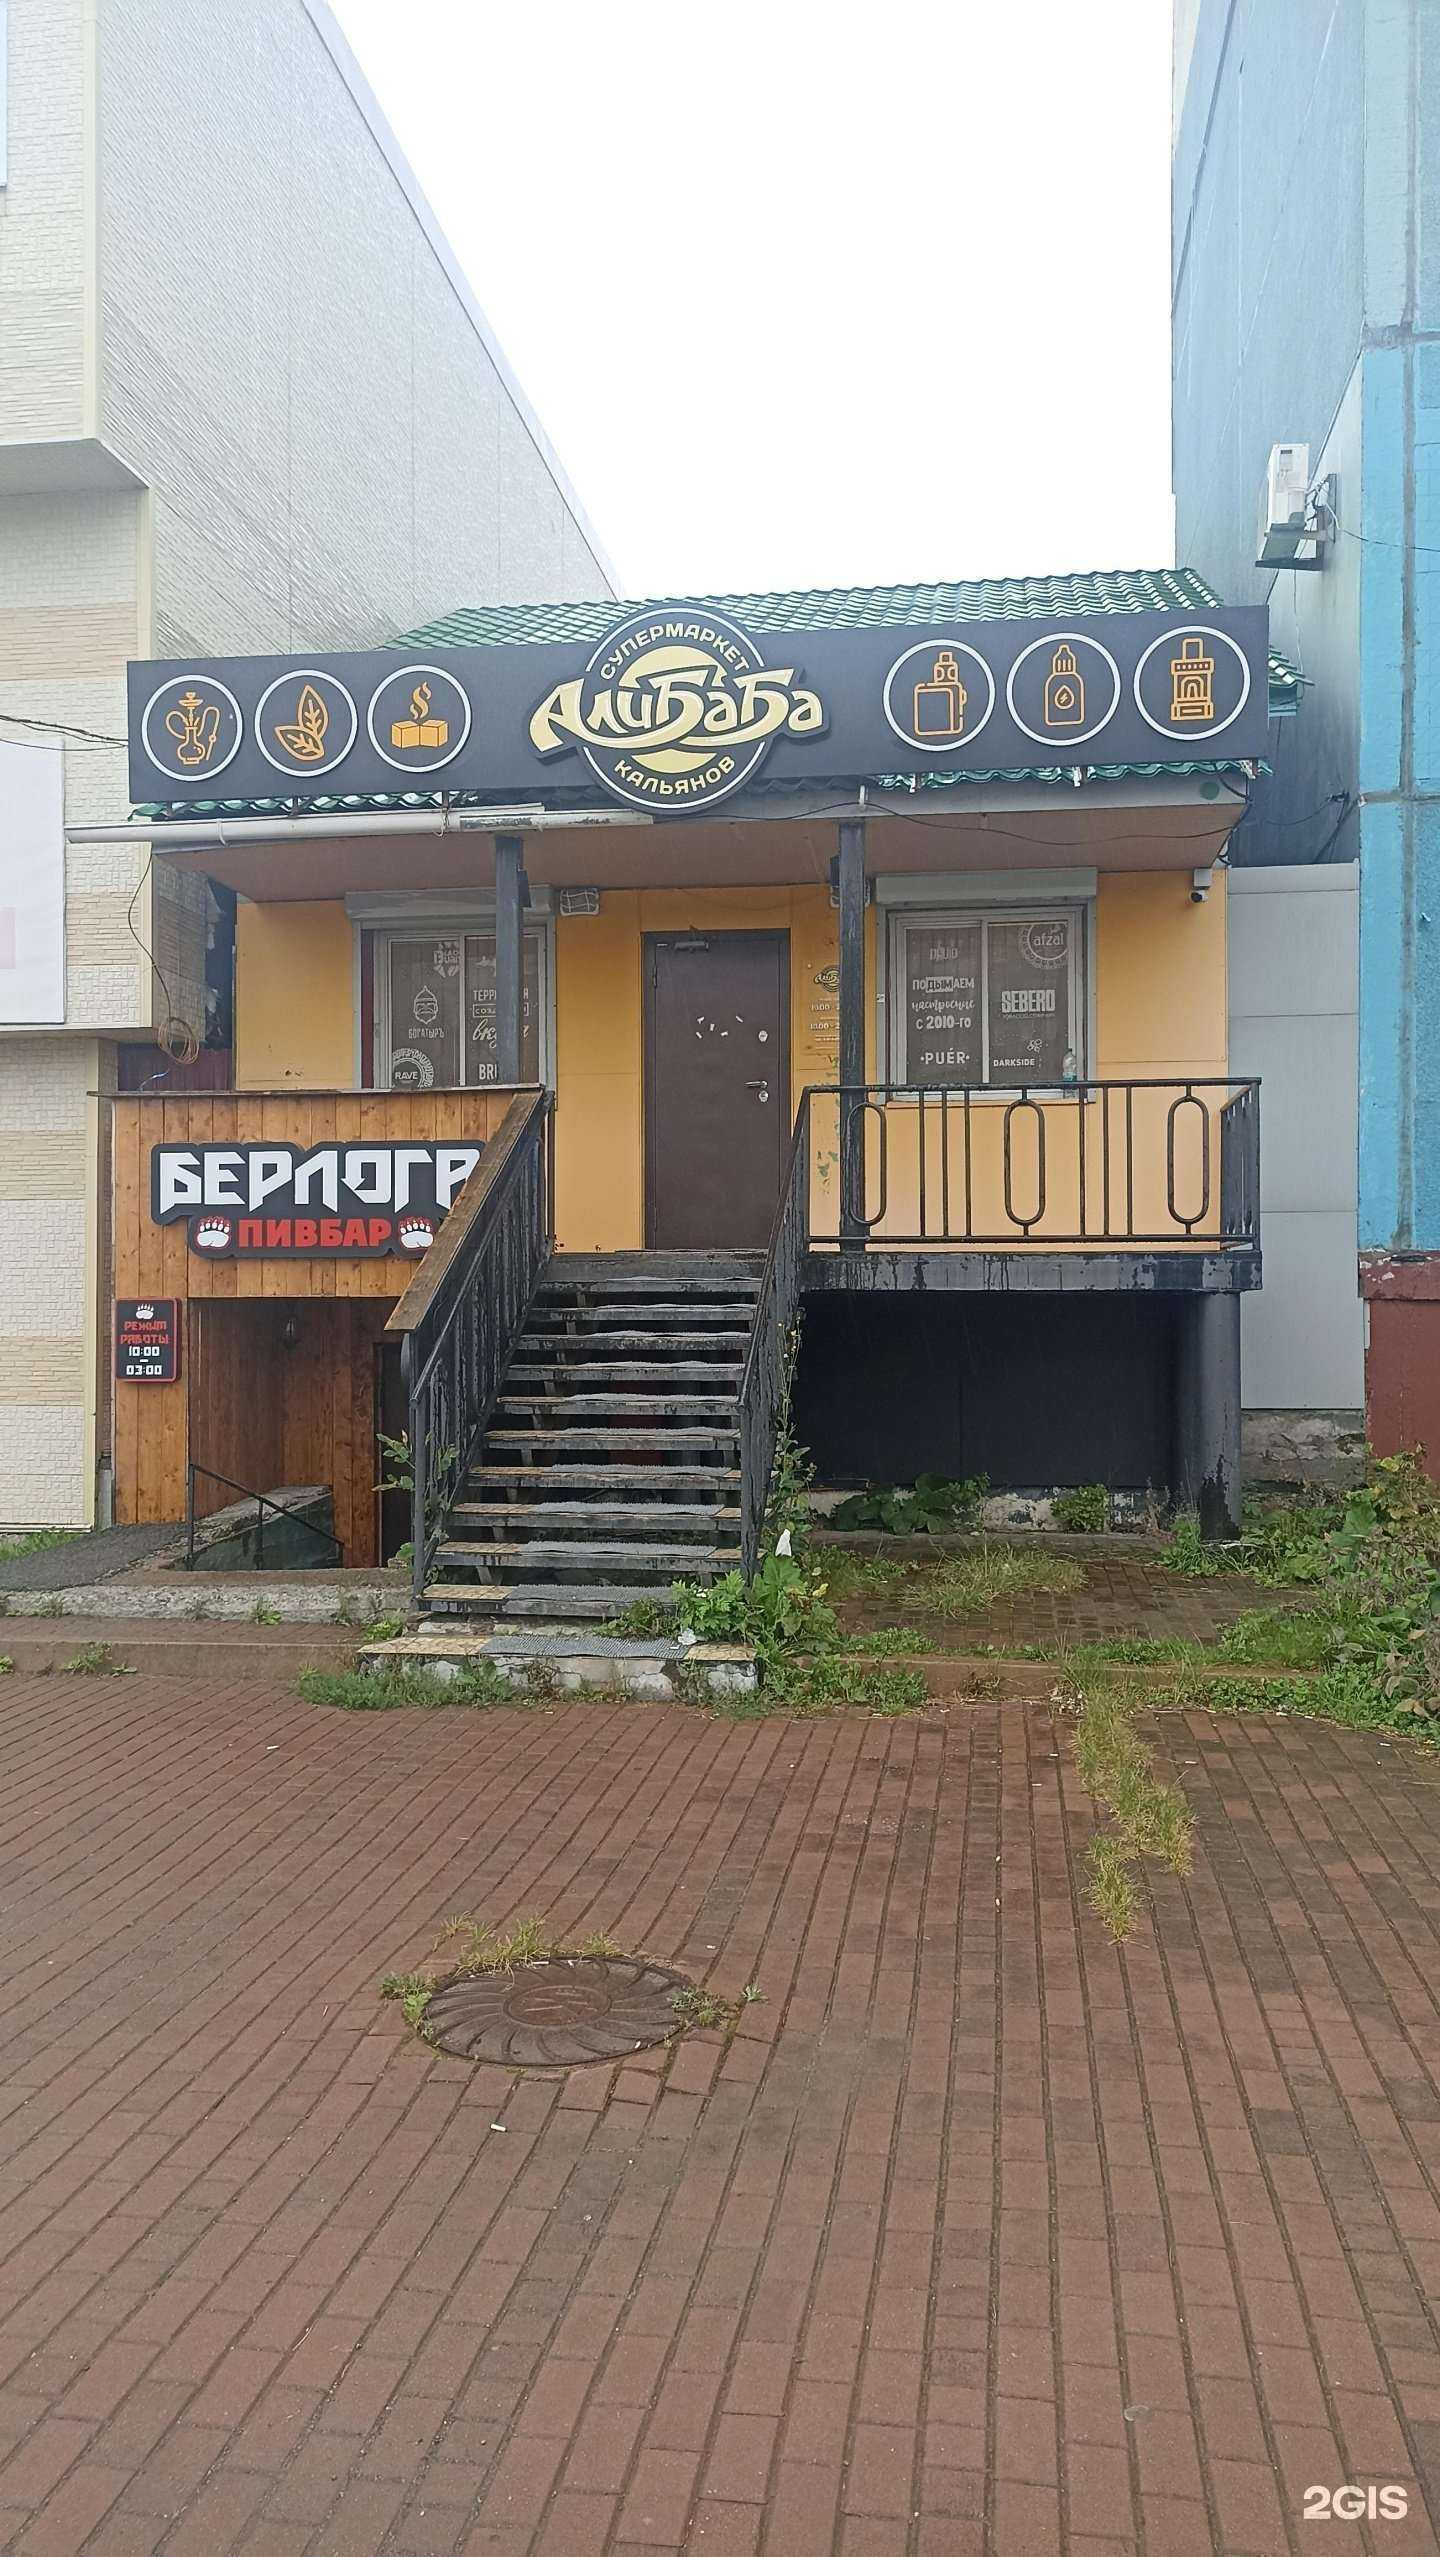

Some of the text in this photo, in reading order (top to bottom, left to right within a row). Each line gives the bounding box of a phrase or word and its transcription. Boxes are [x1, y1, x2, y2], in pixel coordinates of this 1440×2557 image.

[600, 622, 750, 681] СУПЕРМАРКЕТ
[614, 755, 736, 795] КАЛЬЯНОВ
[1033, 931, 1064, 946] afzal
[1001, 989, 1056, 1014] SEBERO
[926, 1015, 972, 1030] 2010-го
[408, 1027, 445, 1039] БОГАТЫРЪ
[993, 1058, 1035, 1067] DARKSIDE
[394, 1071, 419, 1080] RAVE
[238, 1217, 392, 1249] ПИВБАР
[124, 1320, 167, 1331] РЕЖИМ
[120, 1333, 169, 1345] РАБОТЫ
[128, 1345, 160, 1357] 10:00
[126, 1364, 162, 1375] 03:00
